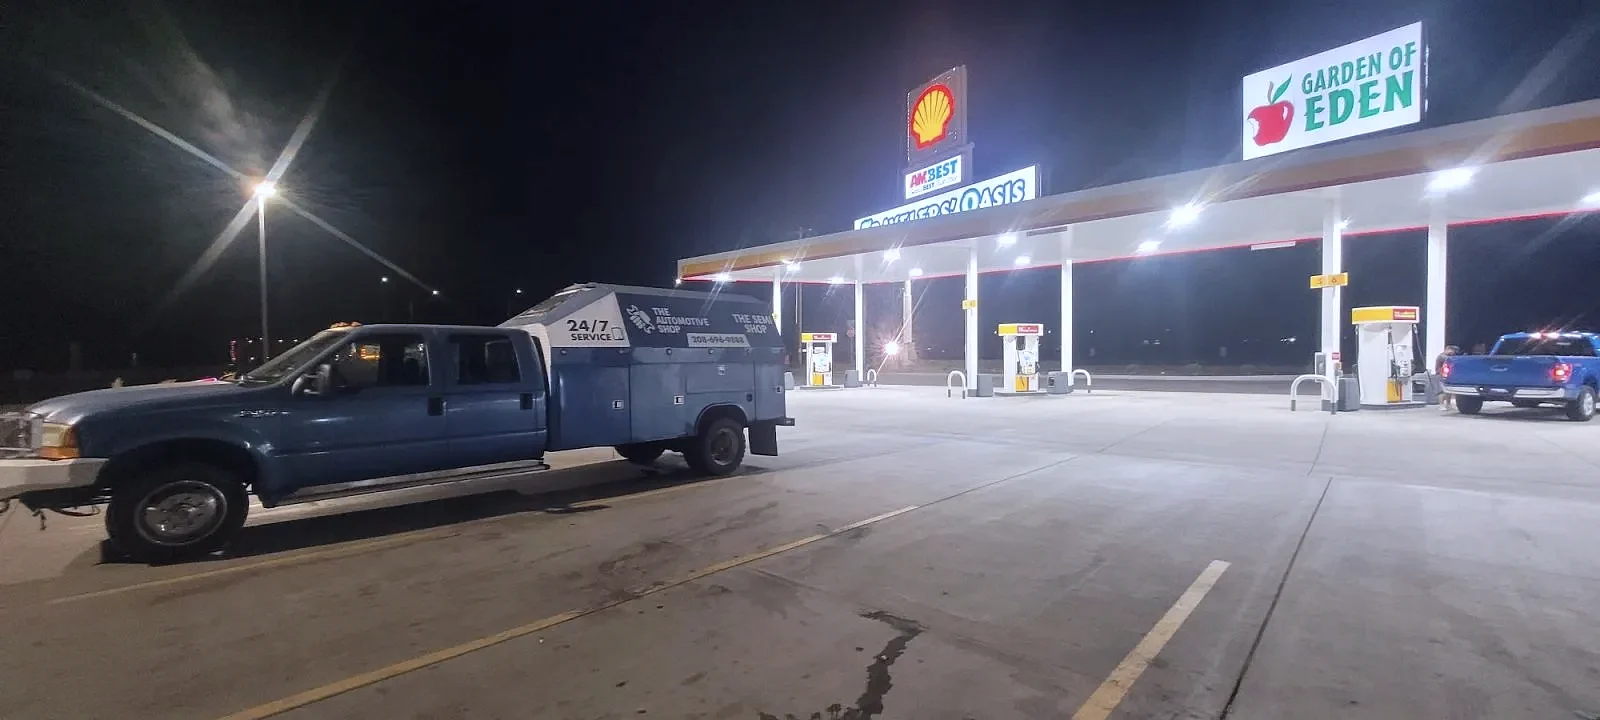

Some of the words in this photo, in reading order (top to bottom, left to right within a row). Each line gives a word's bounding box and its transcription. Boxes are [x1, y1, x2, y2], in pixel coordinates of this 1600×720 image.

[1301, 51, 1382, 95] GARDEN
[1388, 41, 1417, 71] OF
[1303, 70, 1414, 132] EDEN
[959, 178, 1025, 212] OASIS
[652, 307, 671, 316] THE
[656, 316, 710, 326] AUTOMOTIVE
[732, 313, 751, 323] THE
[566, 319, 609, 333] 24/7
[657, 324, 681, 334] SHOP
[744, 323, 767, 334] SHOP
[570, 333, 612, 341] SERVICE
